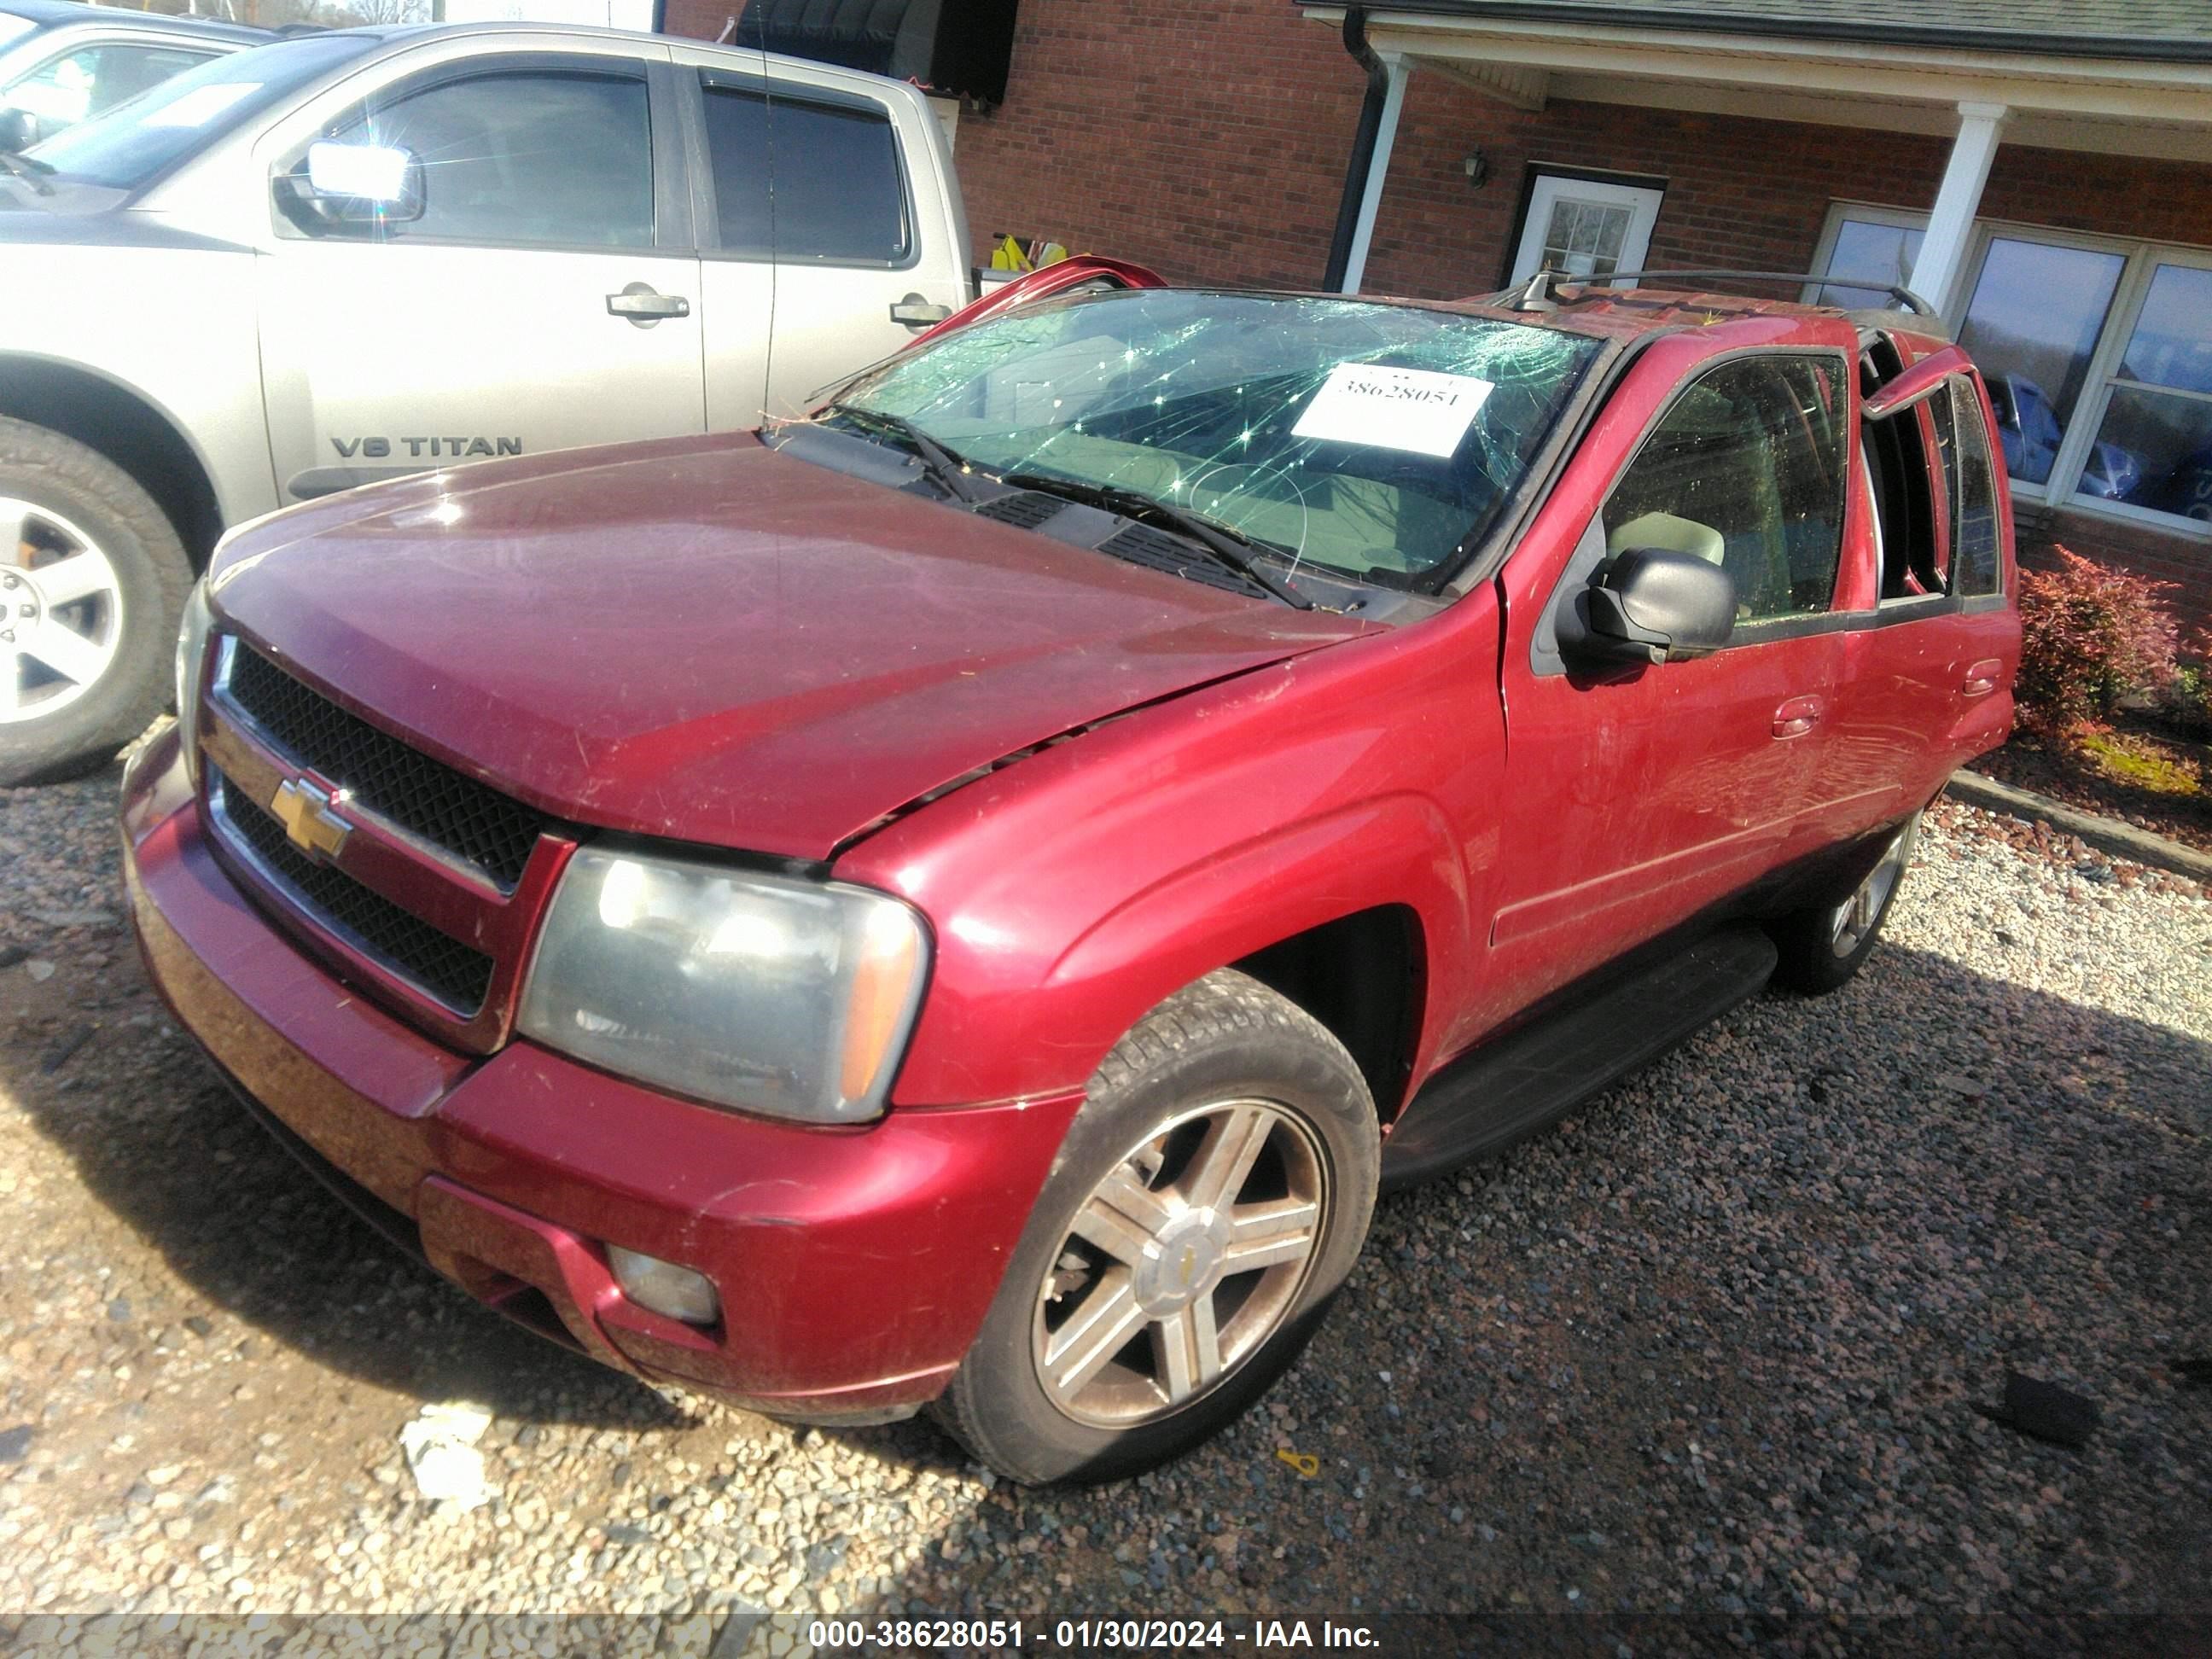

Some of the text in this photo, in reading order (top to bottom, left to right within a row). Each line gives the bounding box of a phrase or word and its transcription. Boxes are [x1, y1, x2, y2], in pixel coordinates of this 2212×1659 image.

[1339, 380, 1459, 406] 38628051
[331, 436, 522, 457] V8 TITAN
